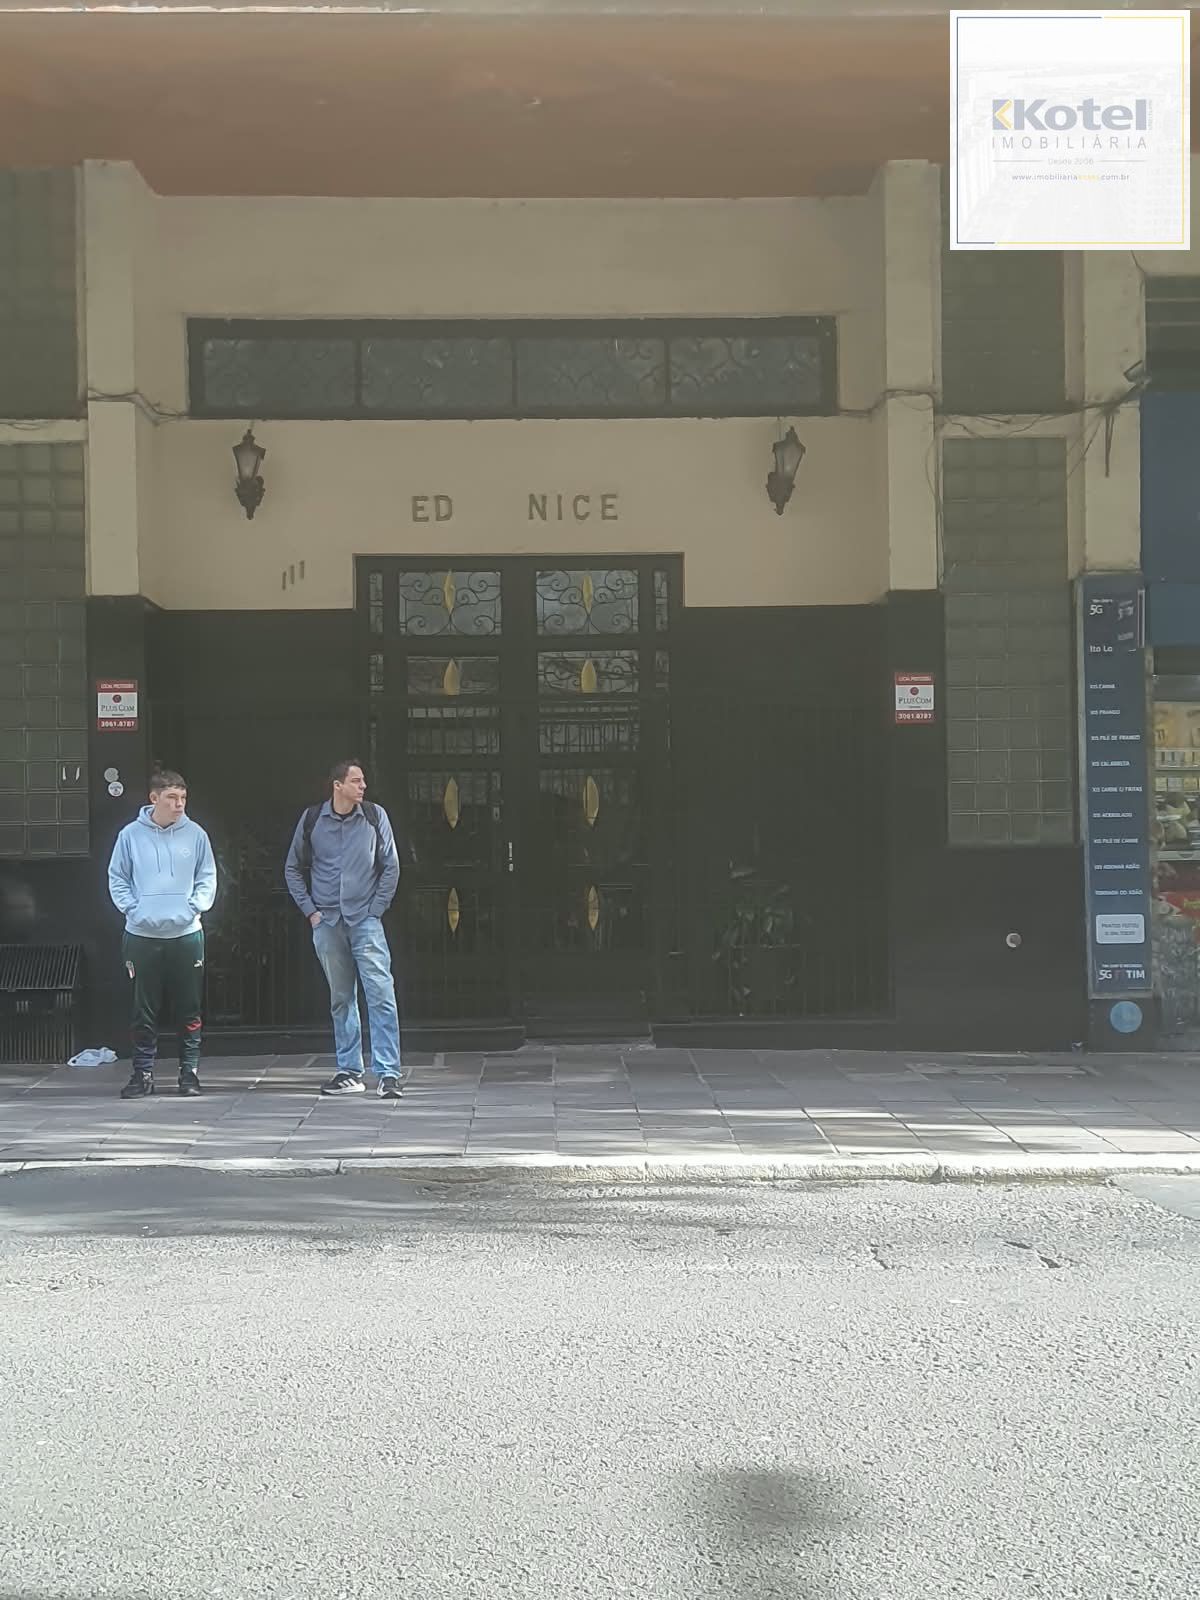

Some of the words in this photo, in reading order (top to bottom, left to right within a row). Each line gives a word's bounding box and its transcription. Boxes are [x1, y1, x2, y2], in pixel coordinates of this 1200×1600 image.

[411, 495, 452, 522] ED
[528, 493, 618, 521] NICE
[1090, 604, 1104, 615] 5G
[1098, 969, 1112, 980] 5G
[1126, 969, 1145, 979] TIM
